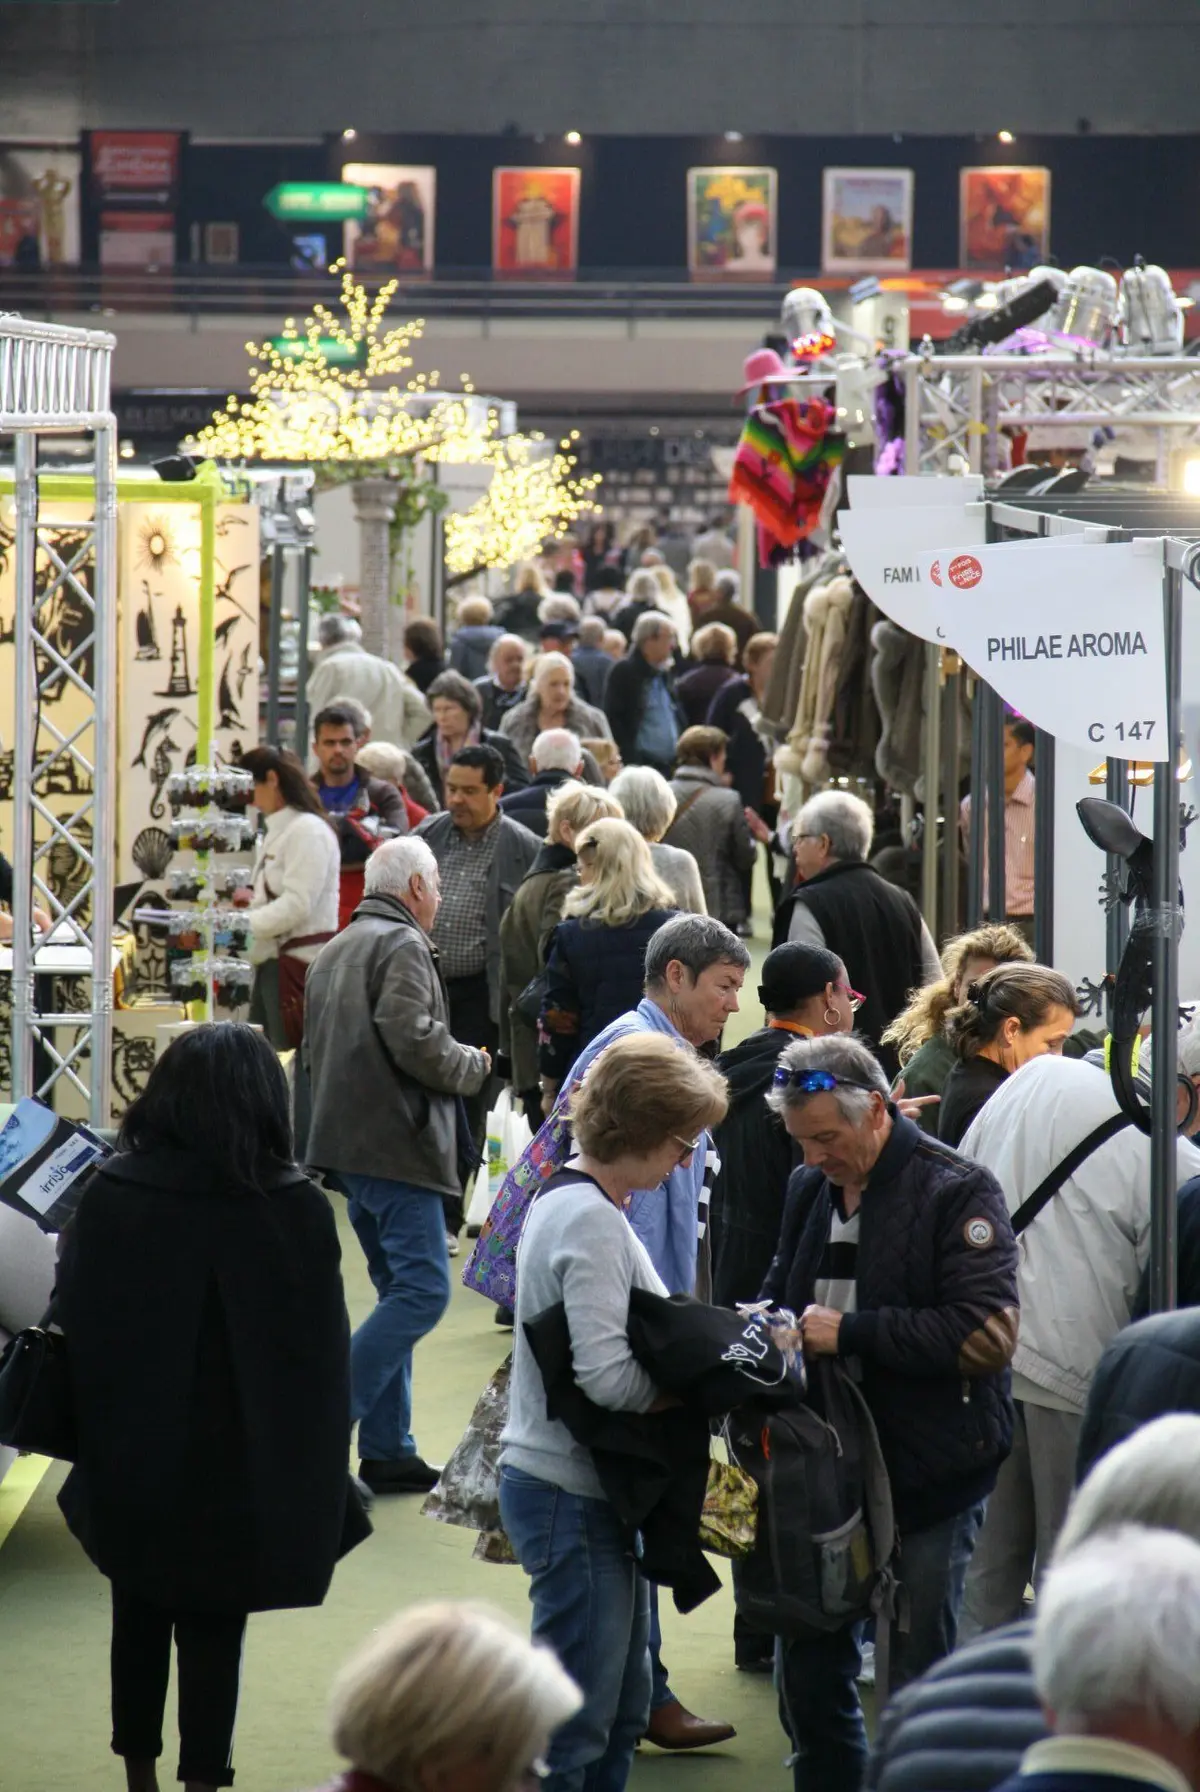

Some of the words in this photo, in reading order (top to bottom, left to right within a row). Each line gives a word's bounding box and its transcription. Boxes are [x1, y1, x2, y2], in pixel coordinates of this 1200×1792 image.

[884, 567, 912, 583] FAM
[987, 634, 1063, 661] PHILAE
[1067, 631, 1148, 658] AROMA
[1088, 722, 1105, 743] C
[1115, 720, 1156, 741] 147
